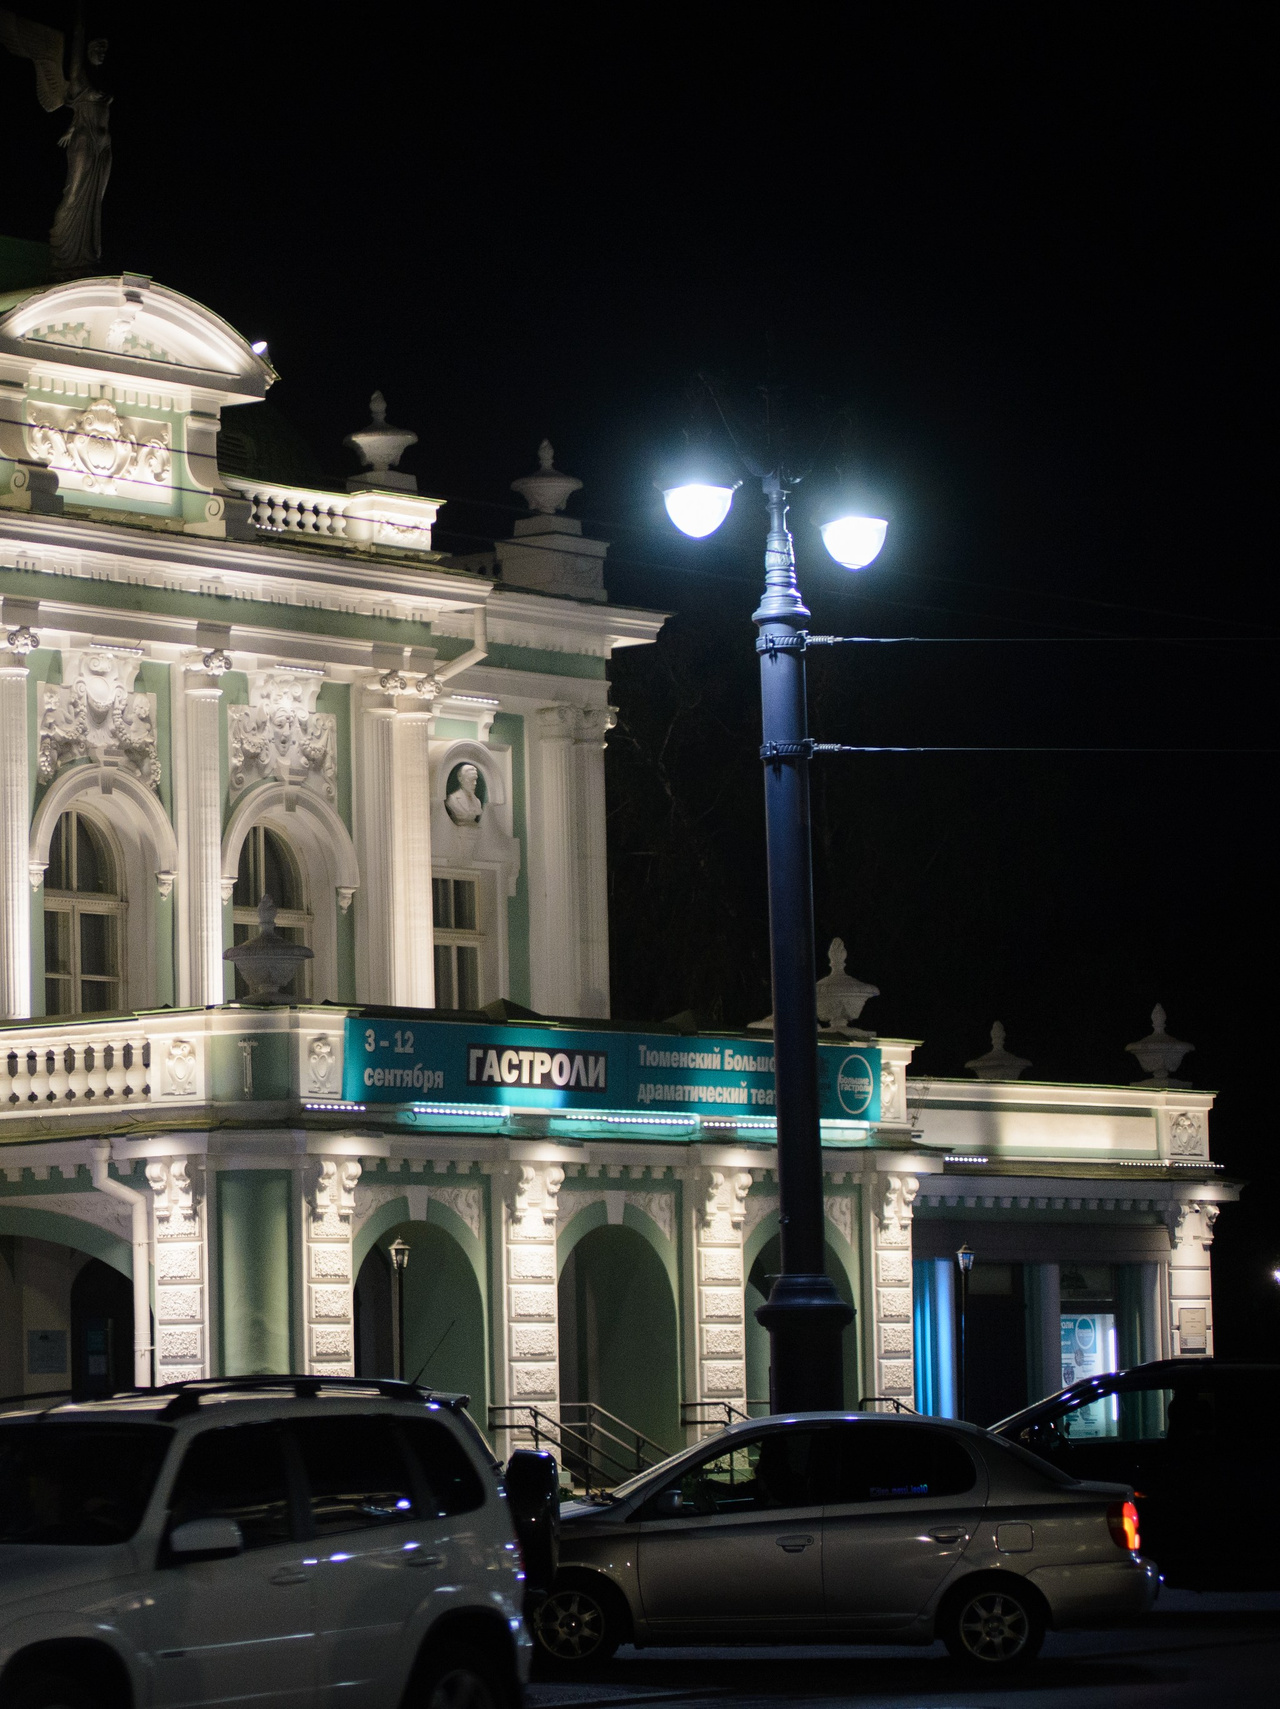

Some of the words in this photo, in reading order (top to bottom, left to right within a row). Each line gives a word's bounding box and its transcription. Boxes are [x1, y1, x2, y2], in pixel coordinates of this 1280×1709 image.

[364, 1028, 376, 1053] 3
[394, 1030, 415, 1054] 12
[468, 1048, 607, 1089] ГАСТРОЛИ
[638, 1044, 721, 1071] Тюменский
[724, 1049, 776, 1073] Большо
[363, 1063, 445, 1094] сентября
[637, 1080, 749, 1104] драматический
